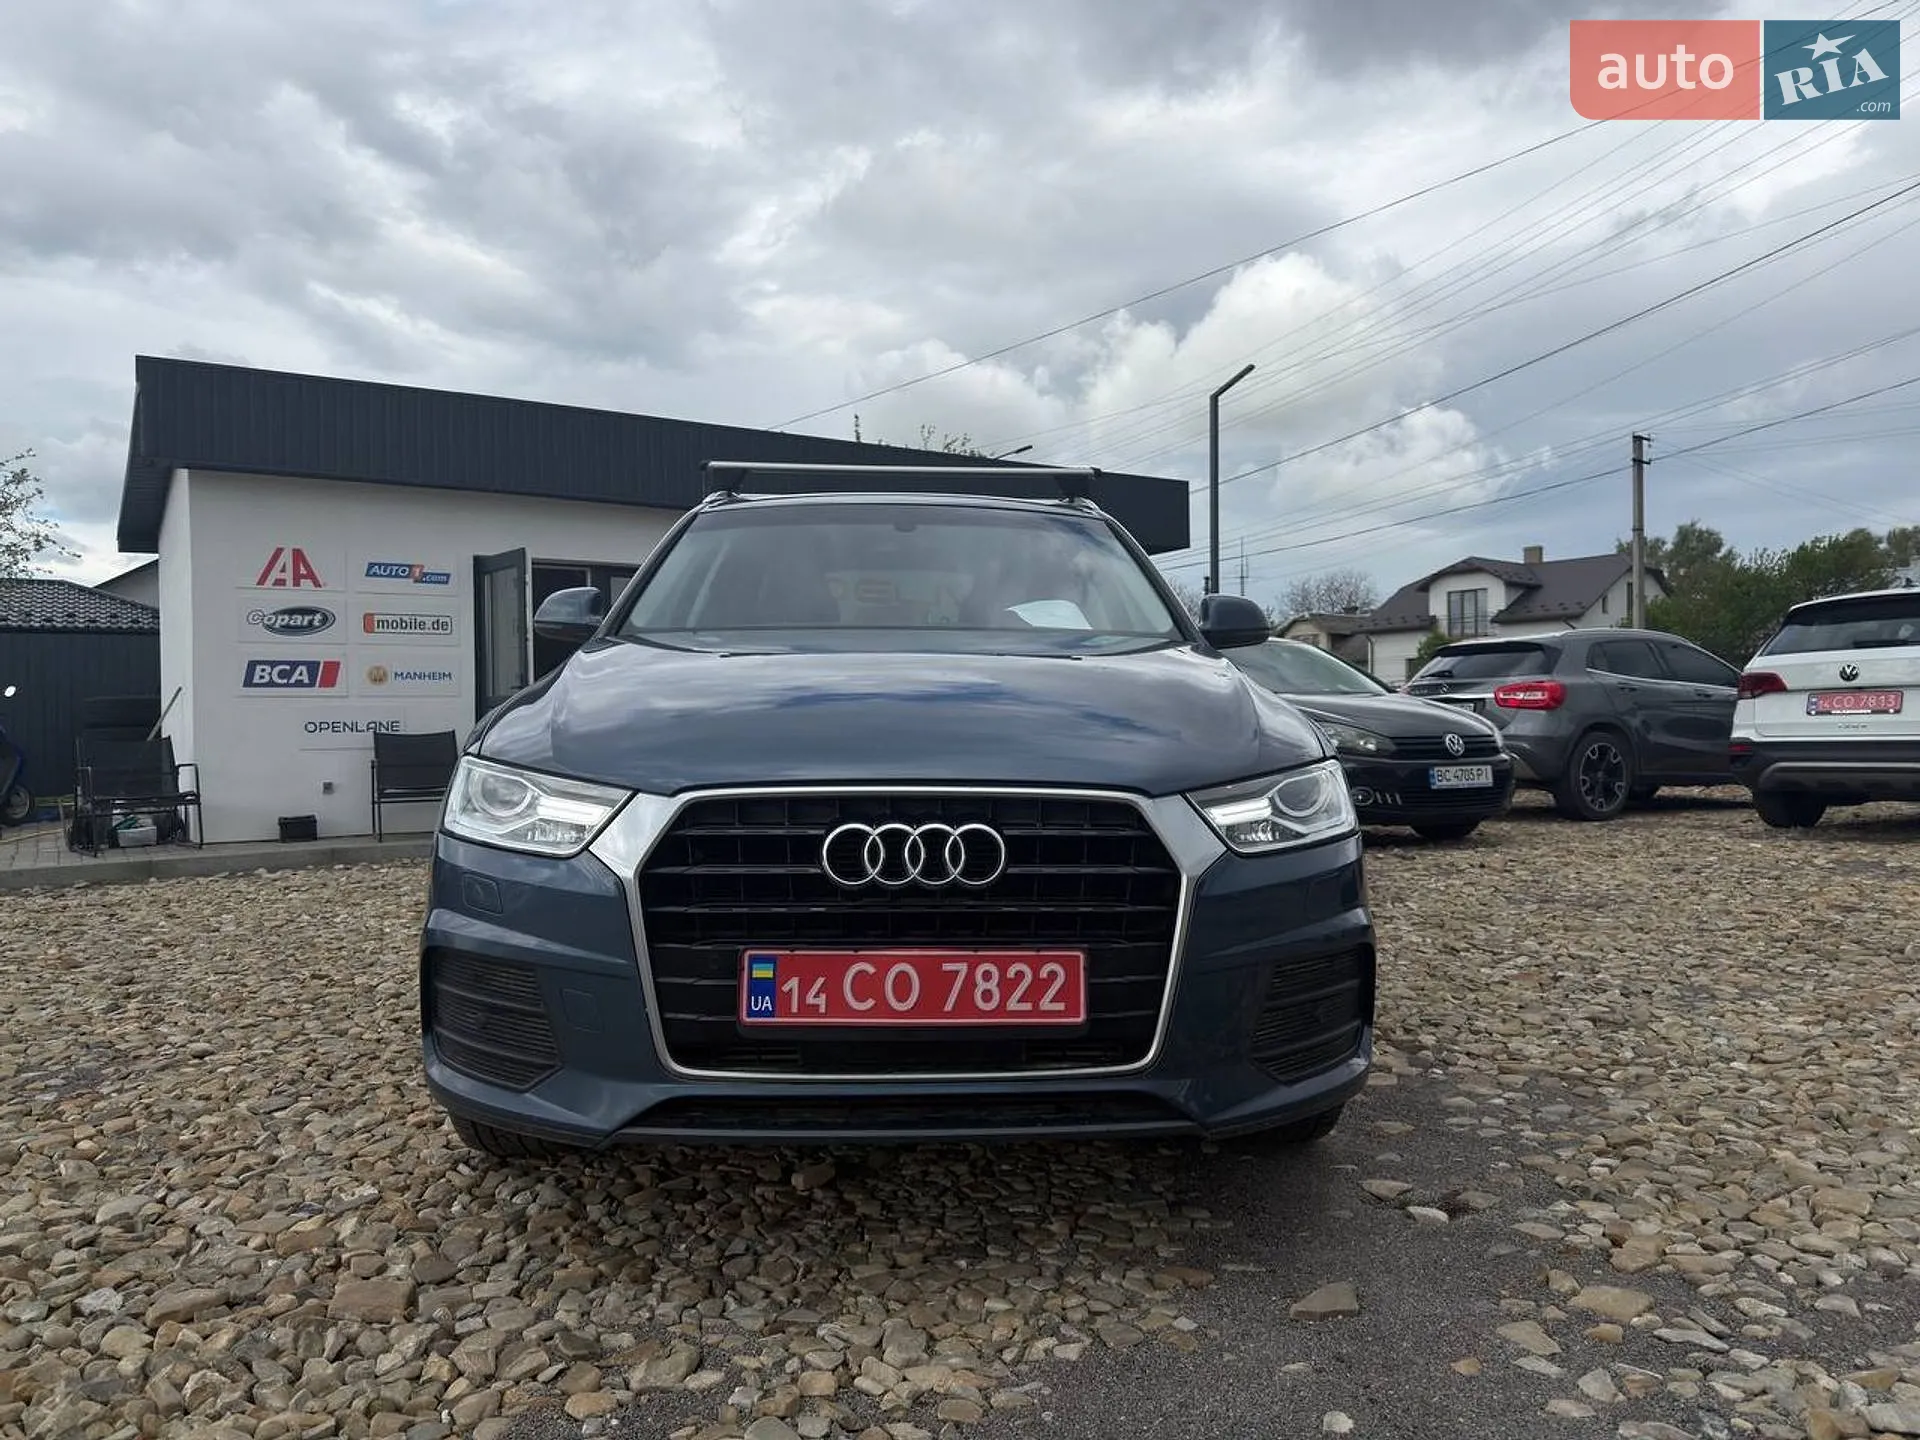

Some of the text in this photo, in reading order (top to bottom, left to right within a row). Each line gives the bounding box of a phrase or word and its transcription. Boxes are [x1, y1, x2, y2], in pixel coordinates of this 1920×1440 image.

[247, 608, 325, 628] Copart
[376, 617, 449, 631] mobile.de
[252, 664, 310, 684] BCA
[394, 671, 453, 681] MANHEIM
[1833, 695, 1855, 708] CO
[304, 720, 400, 733] OPENLANE
[781, 961, 1066, 1013] 14 CO 7822
[751, 996, 773, 1011] UA
